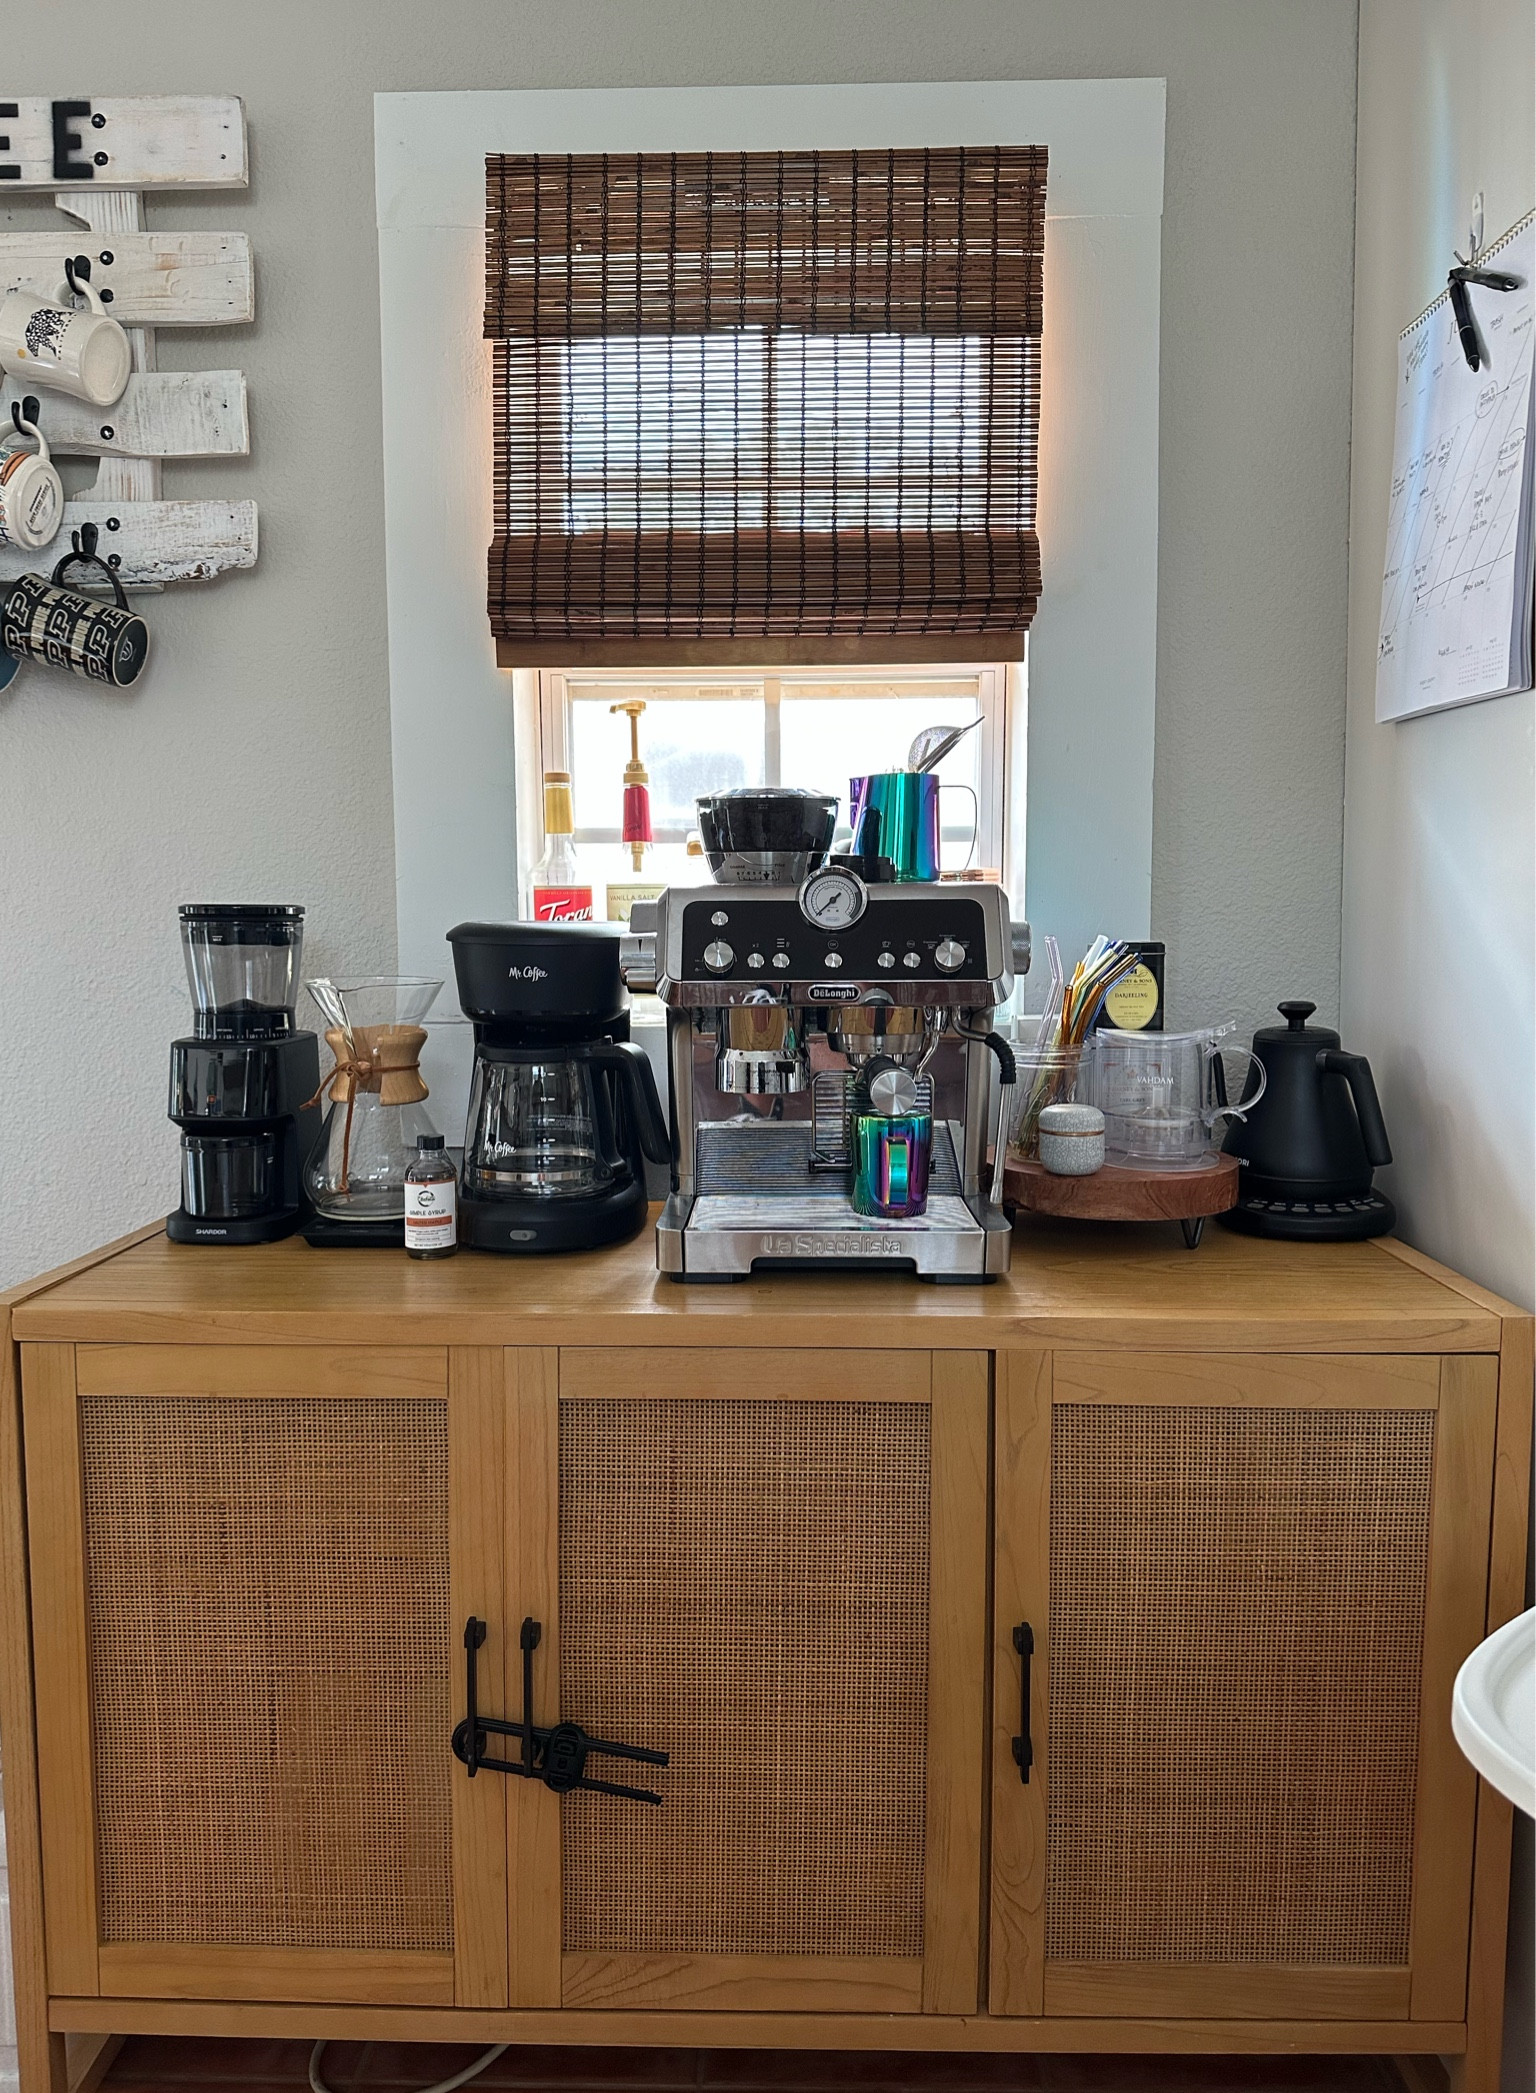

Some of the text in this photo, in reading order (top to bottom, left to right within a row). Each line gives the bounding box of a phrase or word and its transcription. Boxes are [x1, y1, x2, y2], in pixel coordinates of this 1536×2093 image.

[523, 965, 549, 983] Coffee
[1136, 1076, 1174, 1084] VAHDAM
[494, 1141, 517, 1157] Coffee
[1234, 1157, 1250, 1167] ORI
[795, 1235, 902, 1256] Specialista
